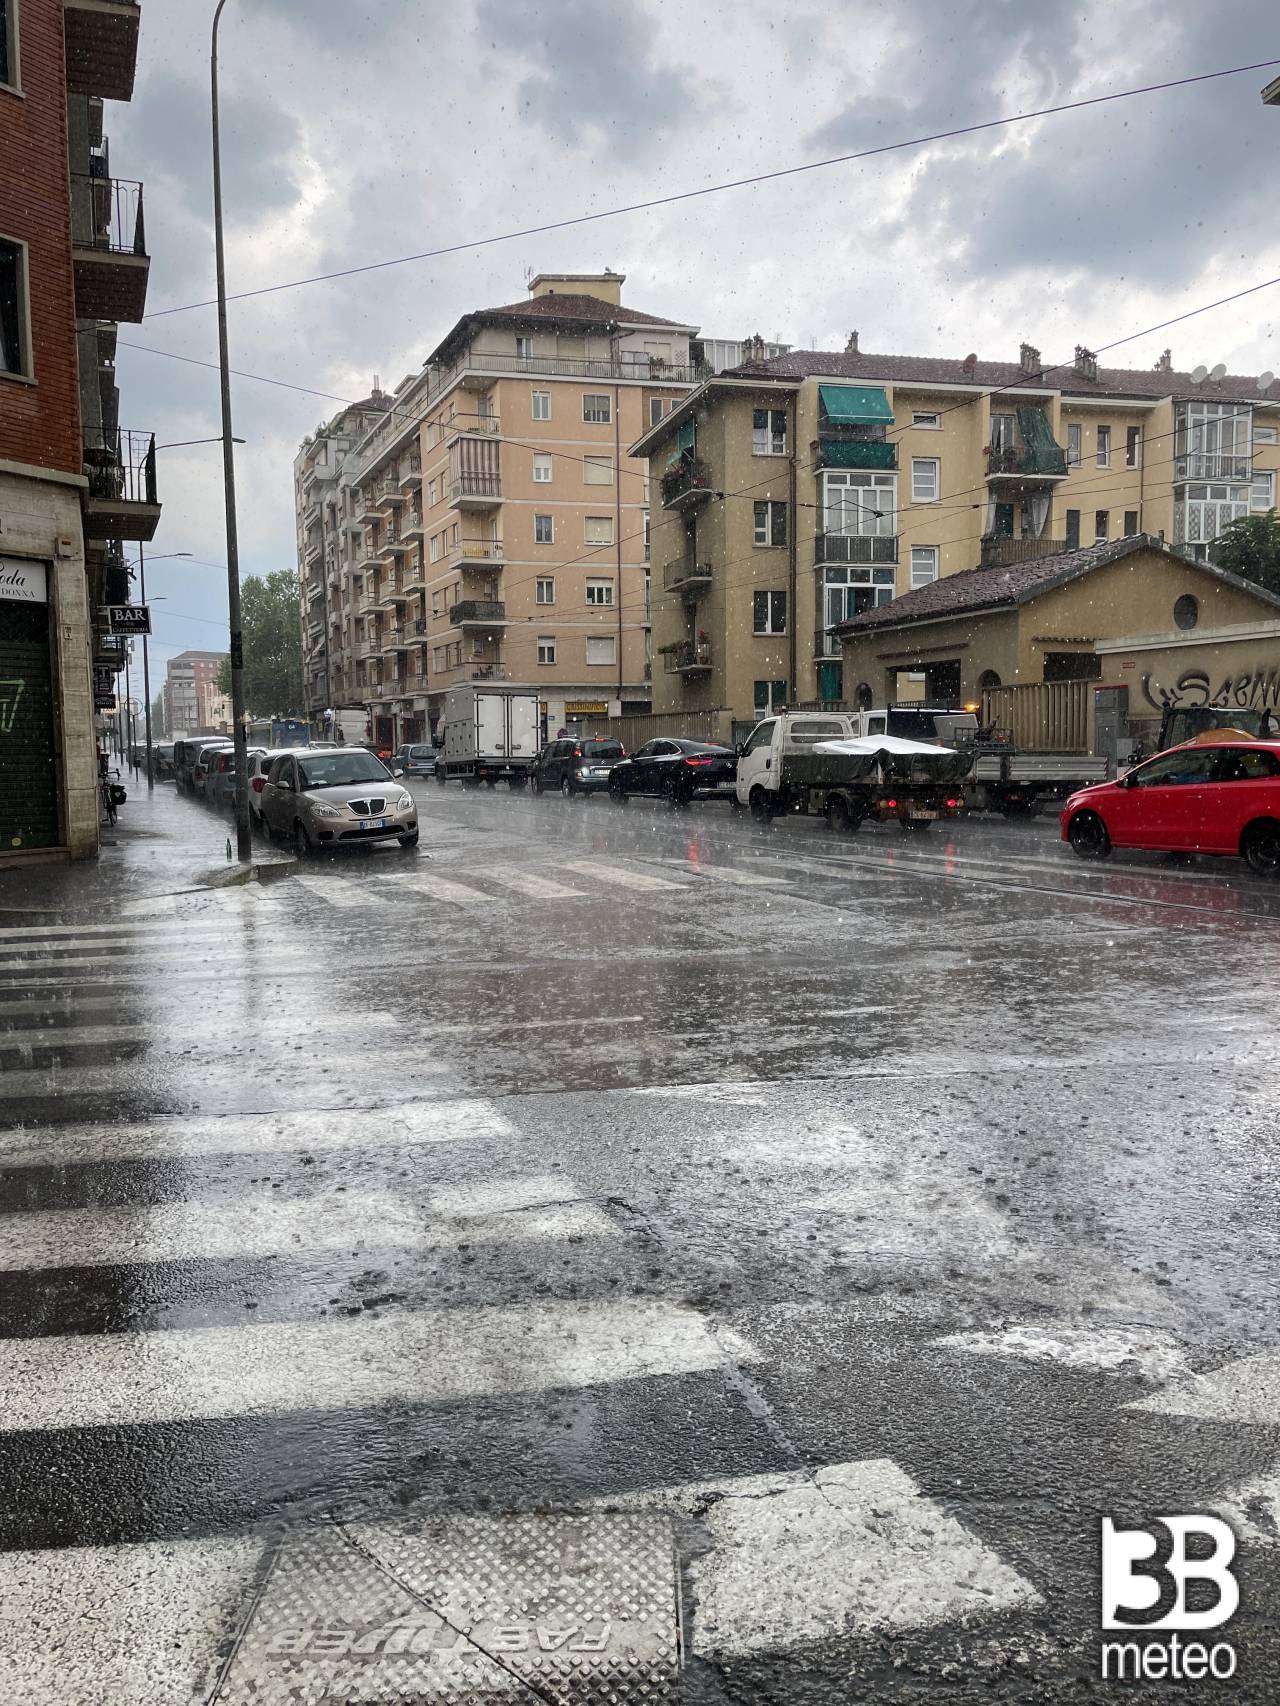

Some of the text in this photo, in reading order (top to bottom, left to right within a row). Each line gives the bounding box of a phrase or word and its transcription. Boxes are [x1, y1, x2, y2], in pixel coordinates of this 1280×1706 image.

[0, 560, 26, 587] oda
[2, 587, 35, 599] DONNA
[113, 609, 147, 621] BAR
